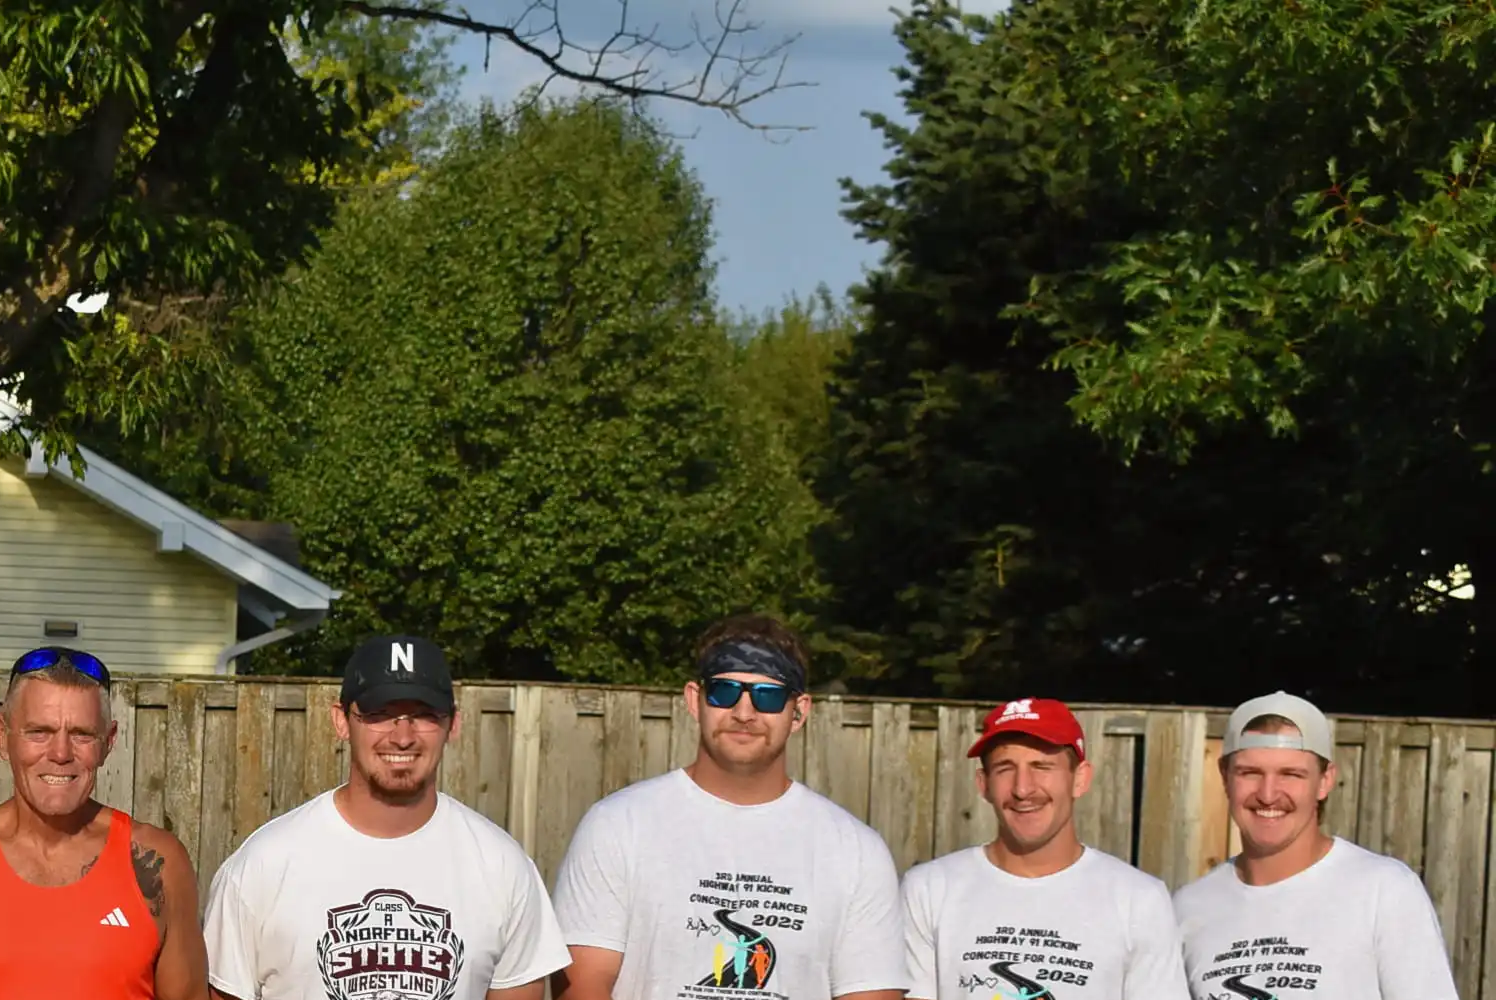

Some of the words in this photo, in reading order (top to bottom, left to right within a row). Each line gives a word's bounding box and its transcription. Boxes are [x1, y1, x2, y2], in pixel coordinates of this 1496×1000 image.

[391, 642, 413, 672] N
[715, 872, 732, 881] 3RD
[736, 873, 773, 883] ANNUAL
[744, 884, 753, 892] 91
[375, 903, 402, 911] CLASS
[690, 894, 736, 909] CONCRETE
[739, 900, 759, 908] FOR
[764, 900, 808, 914] CANCER
[752, 914, 804, 930] 2025
[346, 928, 435, 943] NORFOLK
[996, 927, 1015, 935] 3RD
[1019, 928, 1060, 938] ANNUAL
[976, 936, 1025, 946] HIGHWAY
[1231, 940, 1248, 949] 3RD
[1252, 937, 1288, 946] ANNUAL
[330, 942, 451, 978] STATE
[963, 951, 1020, 961] CONCRETE
[1024, 953, 1045, 963] FOR
[1049, 956, 1093, 970] CANCER
[1036, 969, 1088, 986] 2025
[1203, 965, 1252, 981] CONCRETE
[1255, 964, 1273, 972] FOR
[1277, 963, 1322, 974] CANCER
[348, 975, 433, 994] WRESTLING
[1265, 976, 1317, 990] 2025
